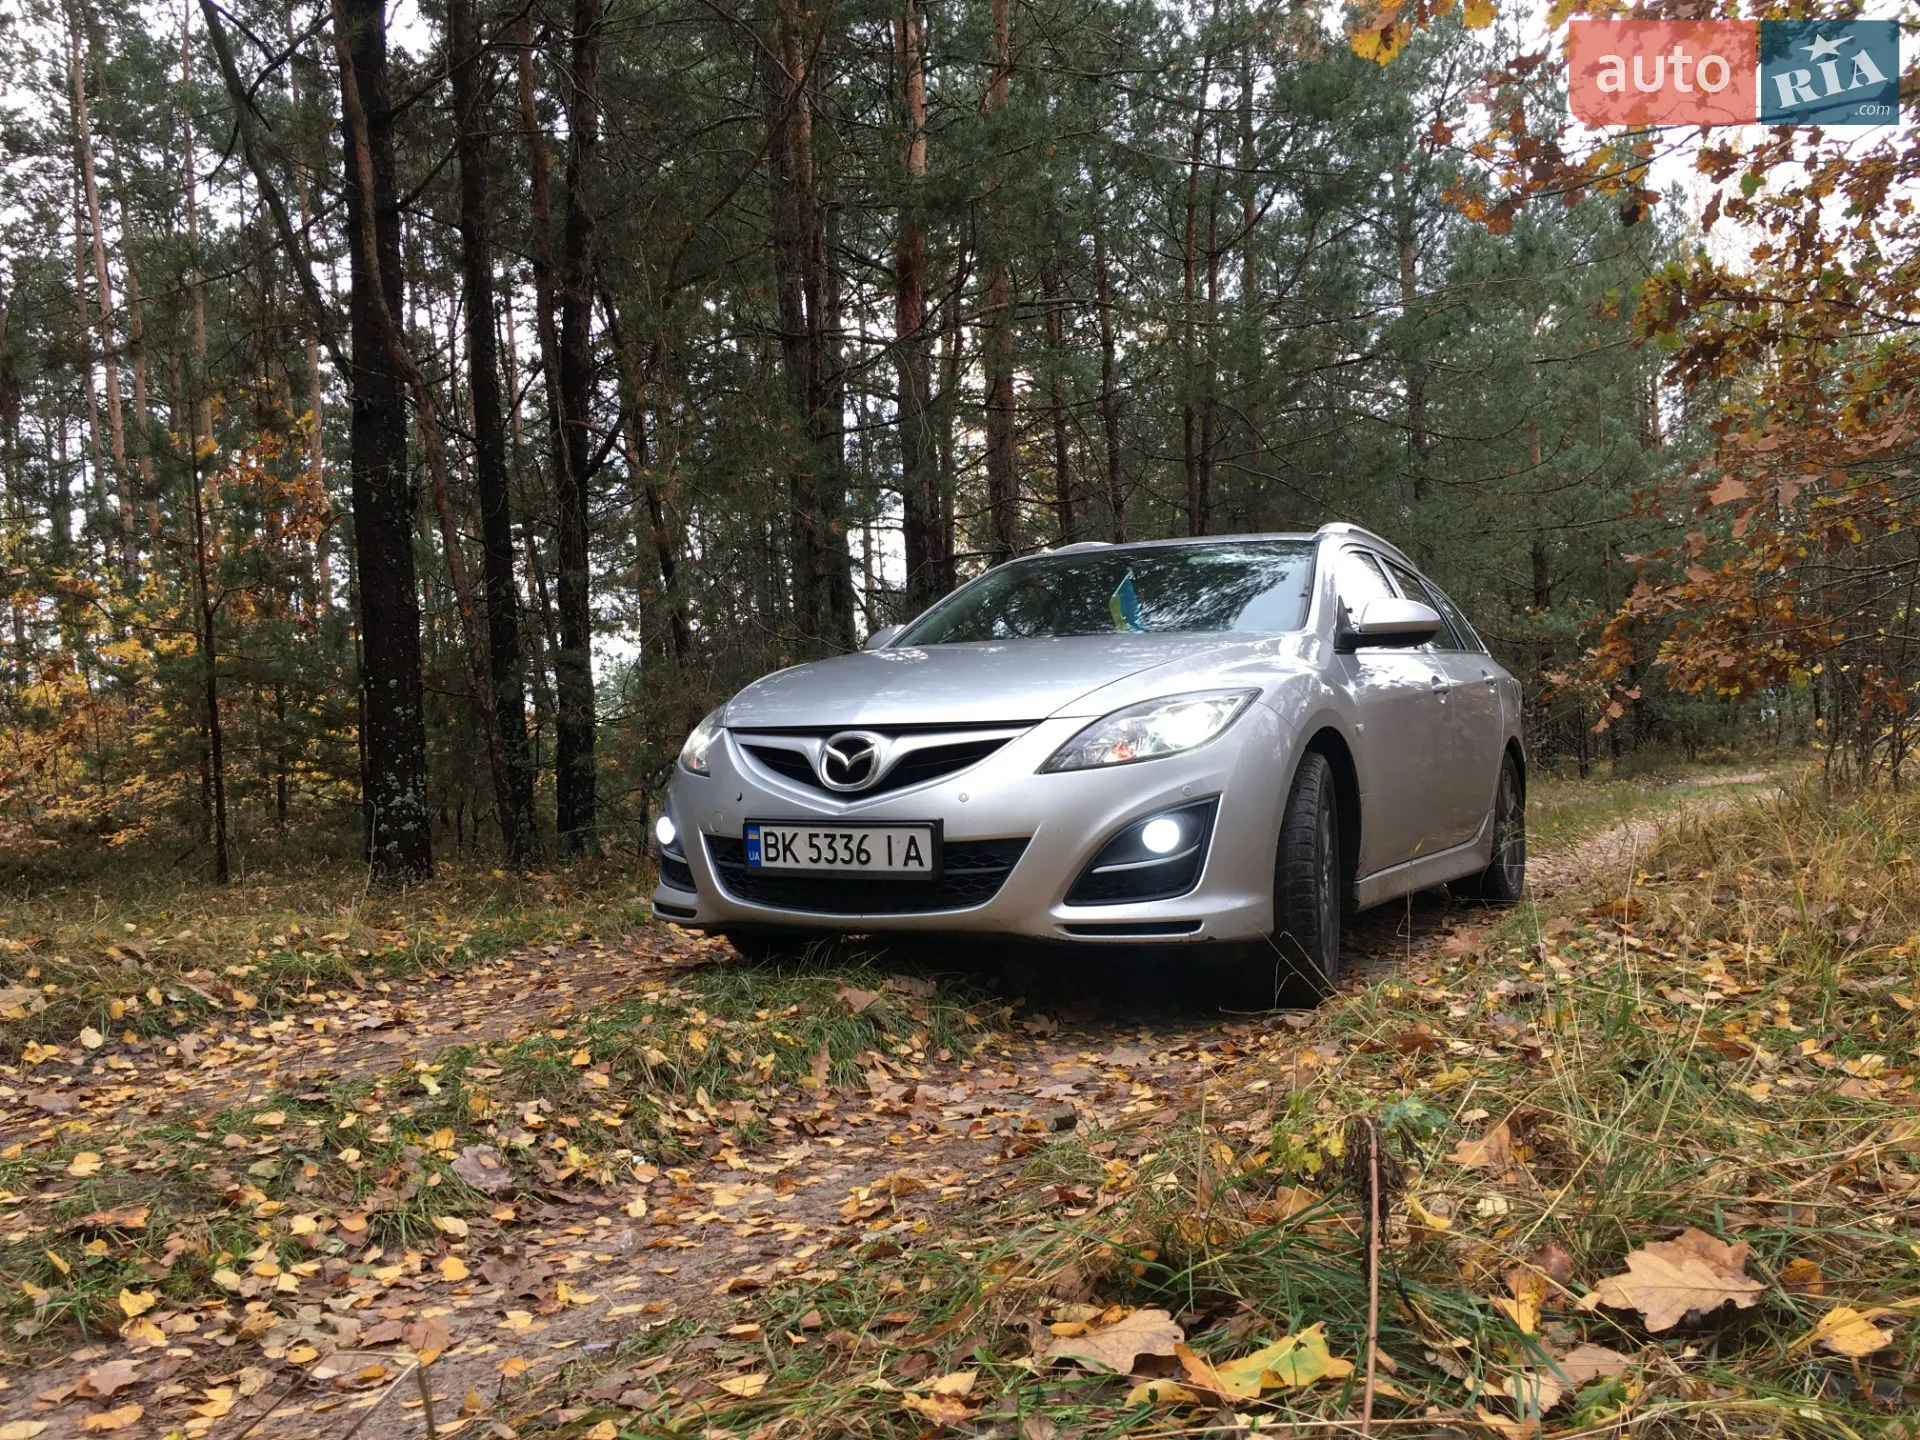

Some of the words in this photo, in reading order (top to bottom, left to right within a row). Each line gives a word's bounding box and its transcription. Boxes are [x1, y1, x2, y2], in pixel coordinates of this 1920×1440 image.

[748, 851, 760, 861] UA
[763, 831, 800, 864] BK
[808, 832, 872, 866] 5336
